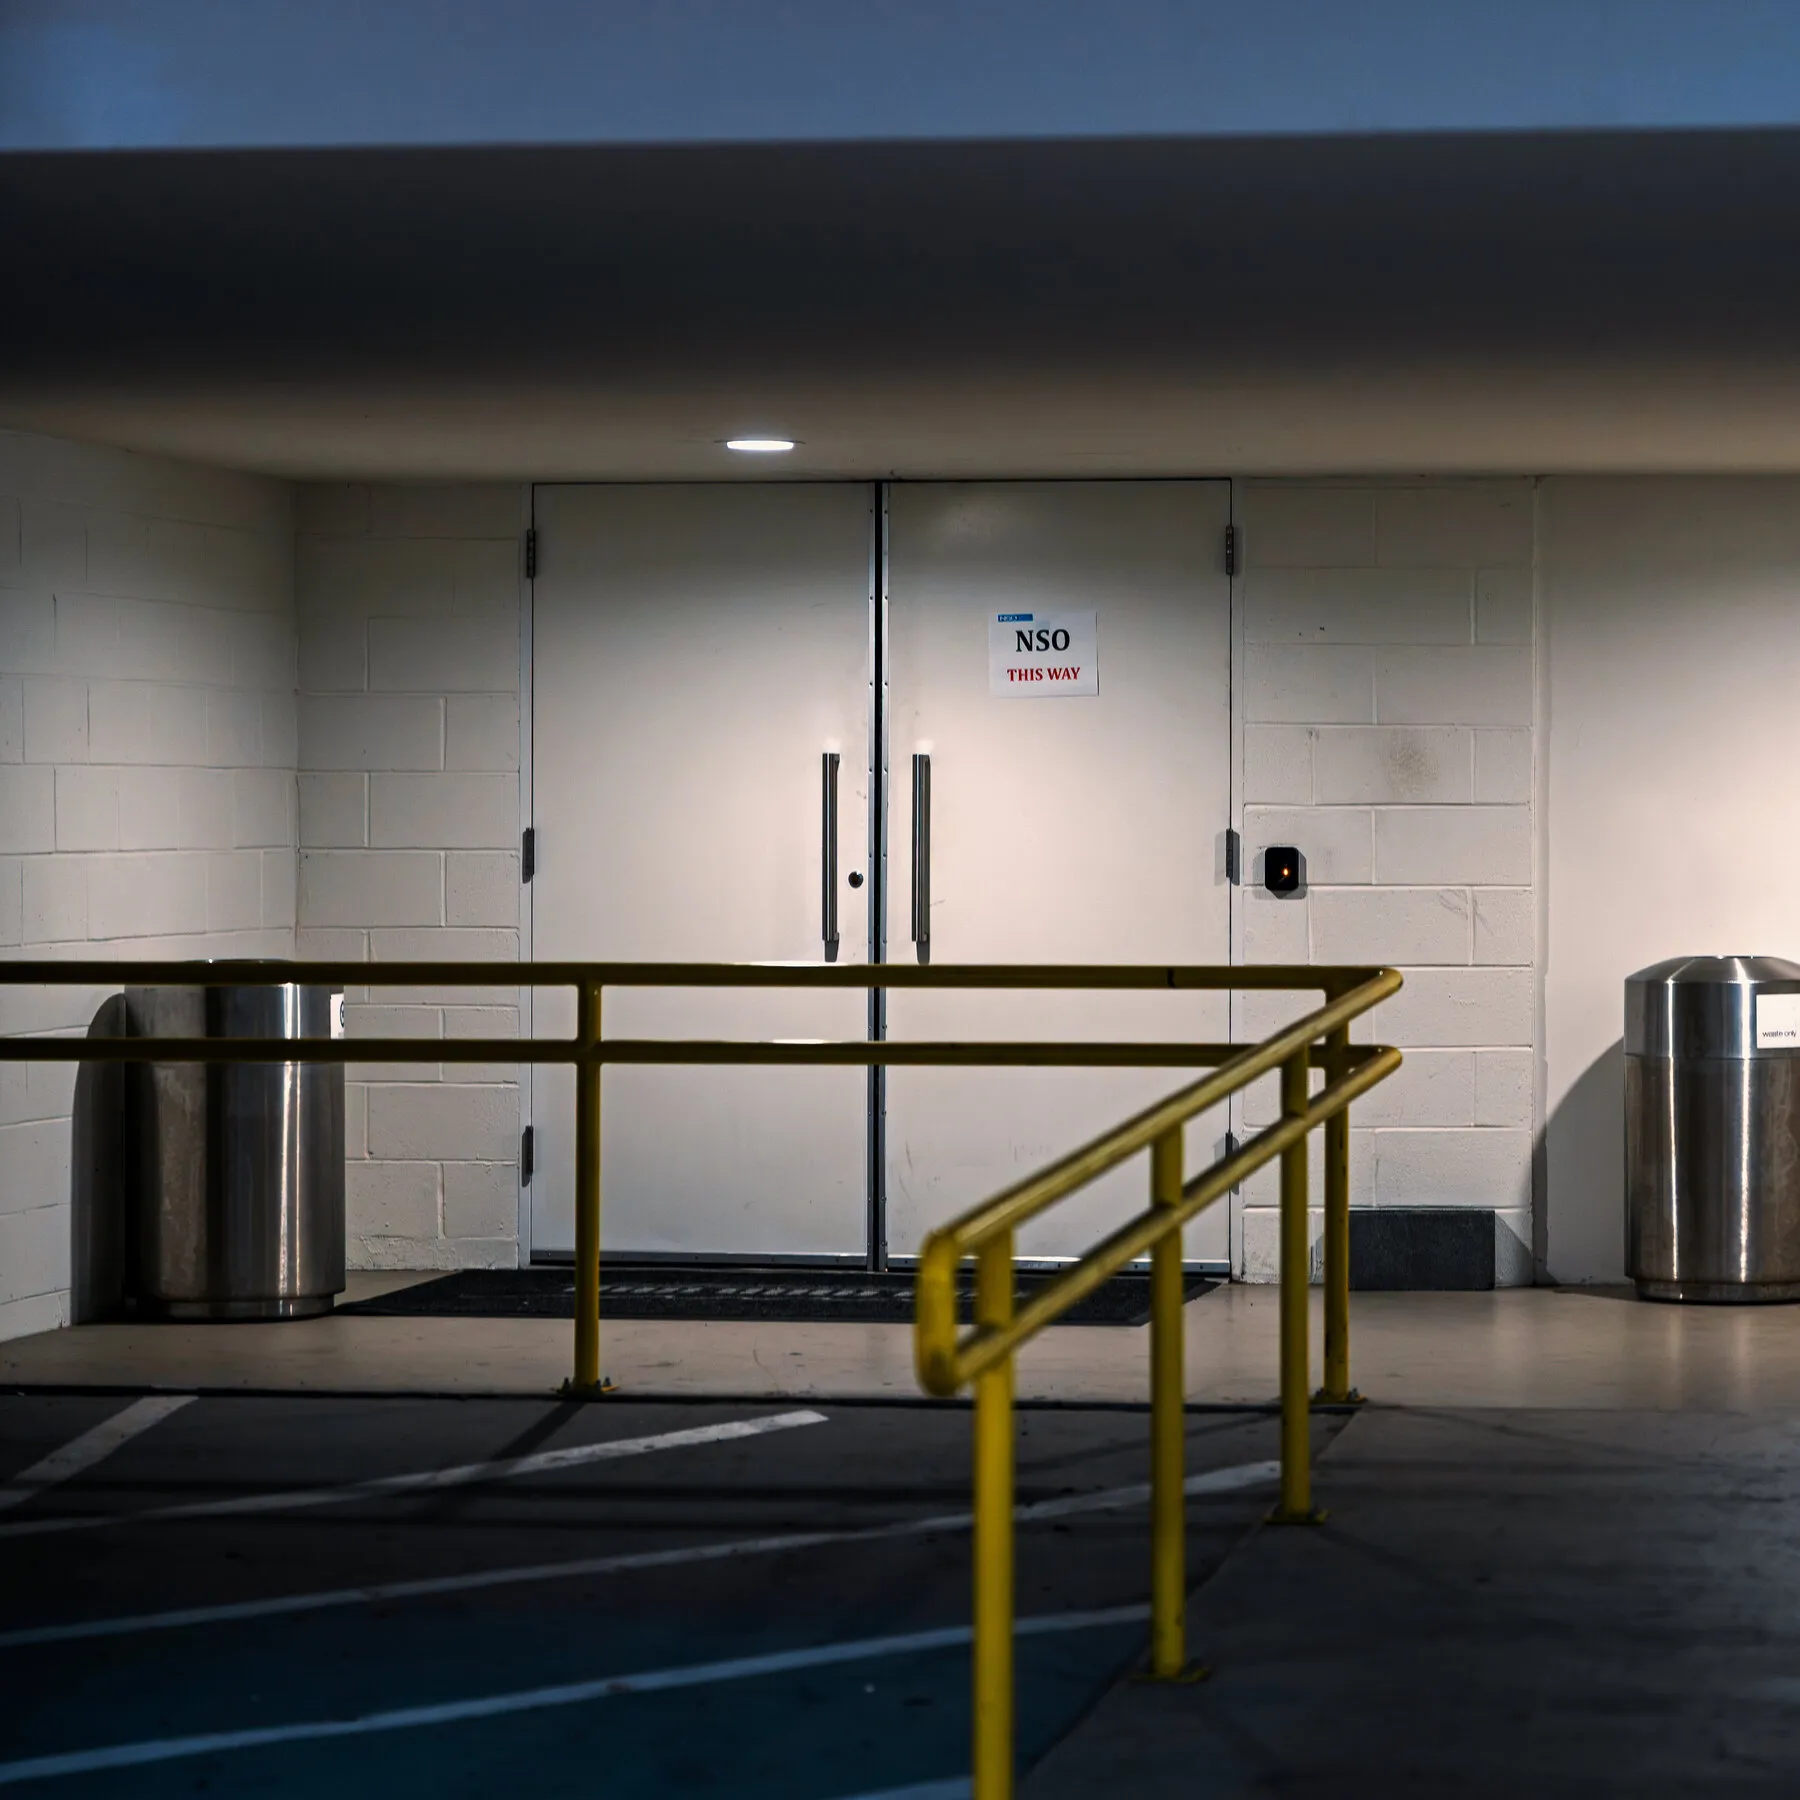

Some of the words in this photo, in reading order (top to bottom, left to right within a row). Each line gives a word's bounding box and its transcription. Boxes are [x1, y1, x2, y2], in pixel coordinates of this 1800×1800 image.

[1015, 629, 1070, 652] NSO
[1006, 667, 1043, 682] THIS
[1046, 666, 1081, 681] WAY
[1784, 1030, 1796, 1038] only
